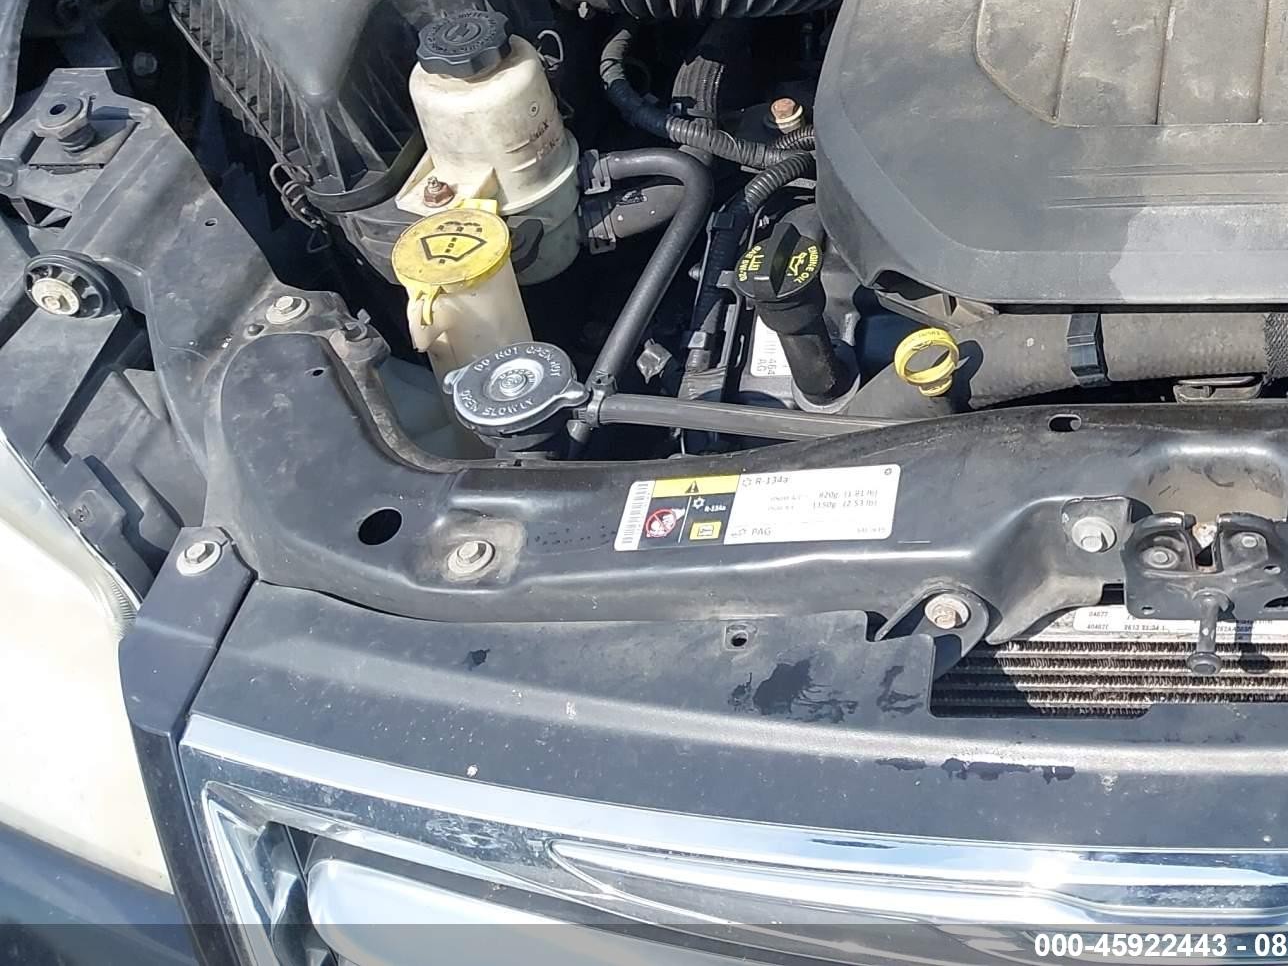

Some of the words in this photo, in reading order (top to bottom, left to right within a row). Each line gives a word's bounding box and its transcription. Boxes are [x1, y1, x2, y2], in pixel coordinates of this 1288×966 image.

[806, 245, 820, 272] ENGINE
[793, 271, 811, 284] OIL
[473, 359, 490, 372] DO
[495, 346, 519, 360] NOT
[482, 397, 535, 417] SLOWLY
[755, 476, 788, 486] R-134a
